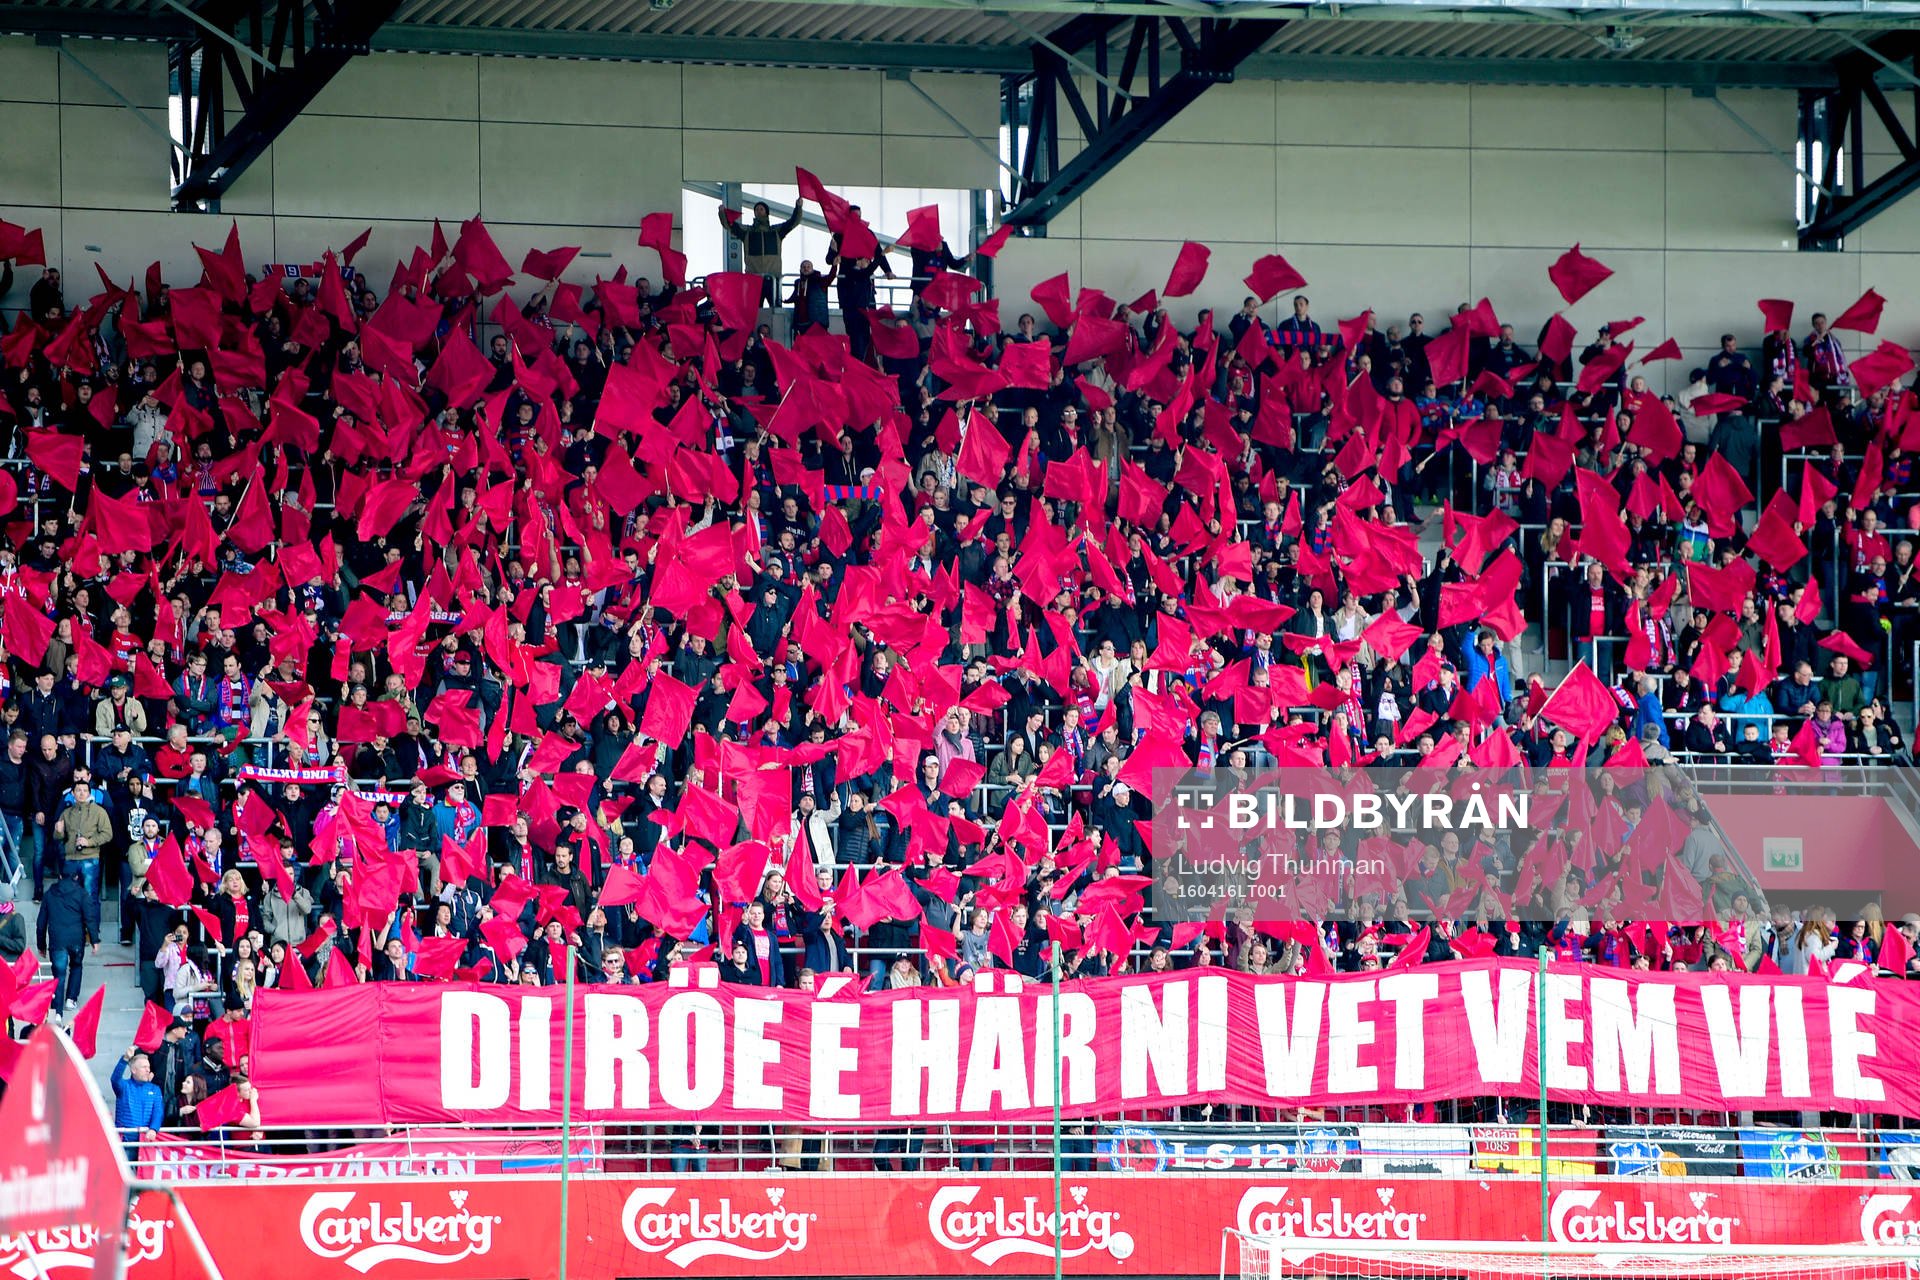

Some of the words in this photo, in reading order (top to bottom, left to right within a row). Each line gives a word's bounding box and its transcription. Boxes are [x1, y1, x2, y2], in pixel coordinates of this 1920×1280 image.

[258, 767, 299, 779] AKTIV
[302, 769, 329, 780] UNG
[440, 990, 552, 1111] DI
[584, 965, 784, 1112] RÖE
[890, 971, 1097, 1117] HÄR
[1121, 974, 1229, 1101] NI
[1254, 973, 1439, 1099] VET
[1459, 967, 1683, 1096] VEM
[1169, 1142, 1236, 1171] LS
[1250, 1142, 1290, 1170] 12
[300, 1190, 493, 1256] Carlsberg
[622, 1187, 809, 1253] Carlsberg
[929, 1185, 1112, 1251] Carlsberg
[1236, 1186, 1419, 1241] Carlsberg
[1550, 1189, 1732, 1245] Carlsberg
